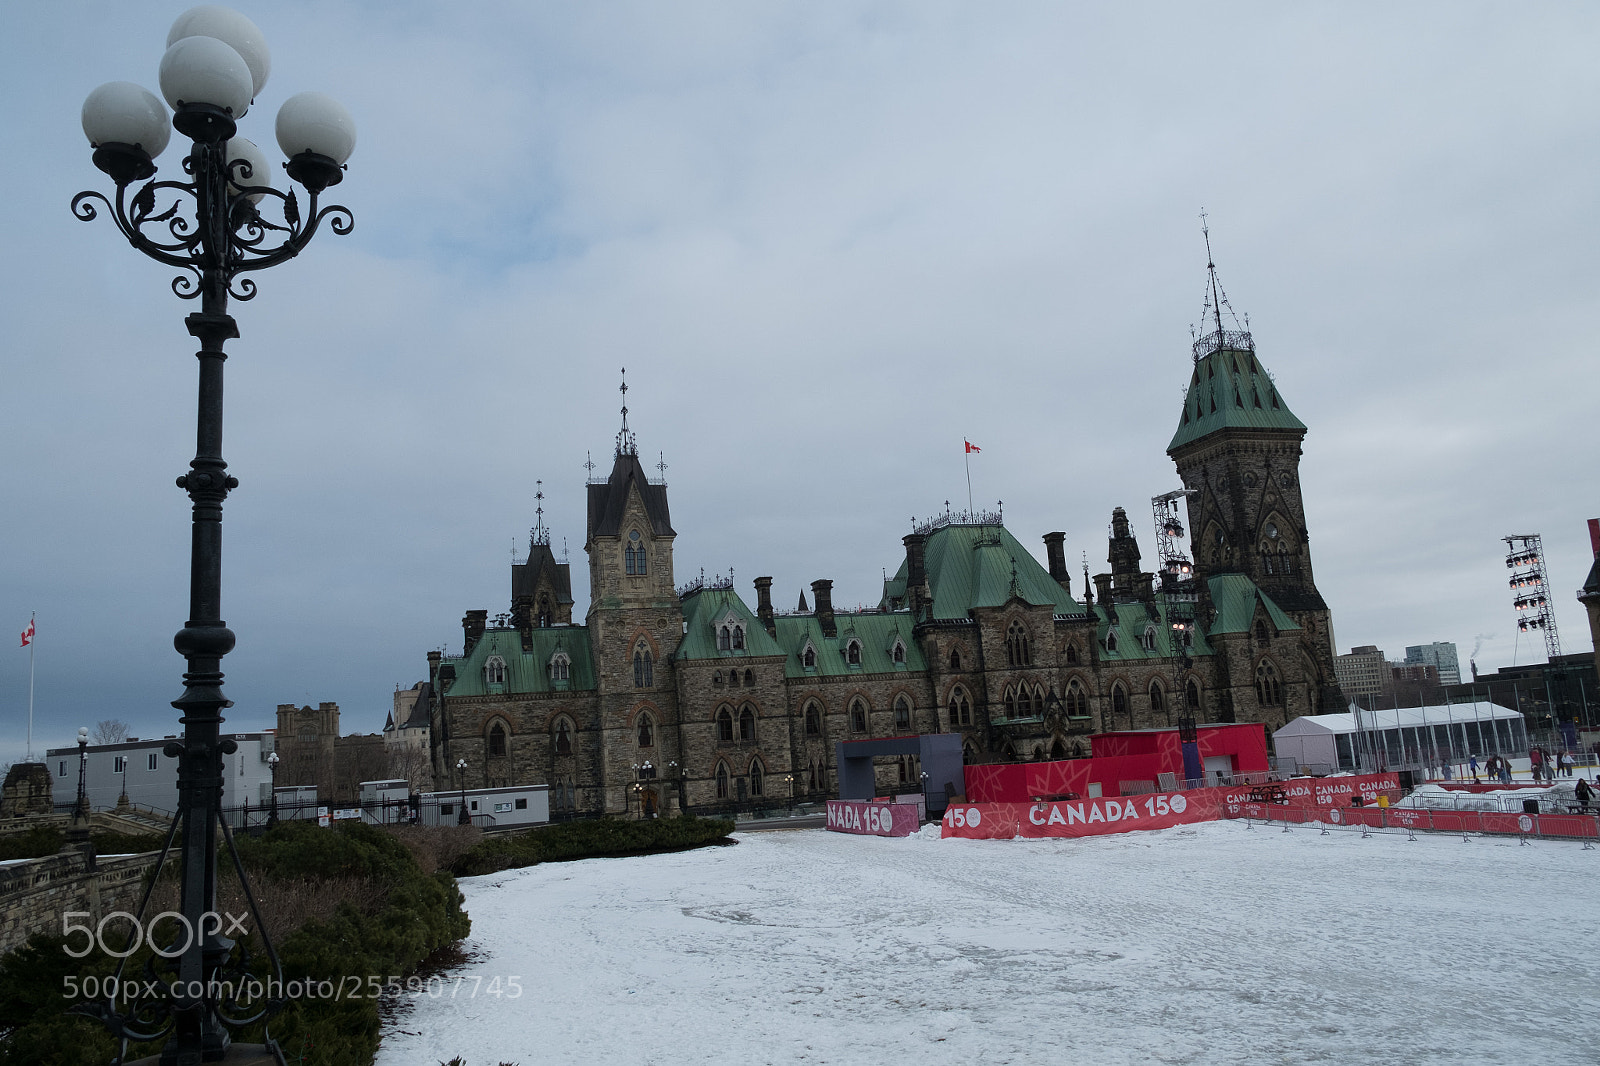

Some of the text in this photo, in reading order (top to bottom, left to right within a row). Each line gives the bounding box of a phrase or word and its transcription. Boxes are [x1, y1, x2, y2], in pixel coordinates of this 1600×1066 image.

[1315, 784, 1353, 795] CANADA
[1359, 780, 1397, 791] CANADA
[1316, 795, 1333, 805] 150
[1361, 791, 1377, 800] 150
[1029, 794, 1187, 826] CANADA 150
[1227, 804, 1241, 814] 15
[827, 804, 893, 833] NADA 150
[943, 807, 982, 828] 150
